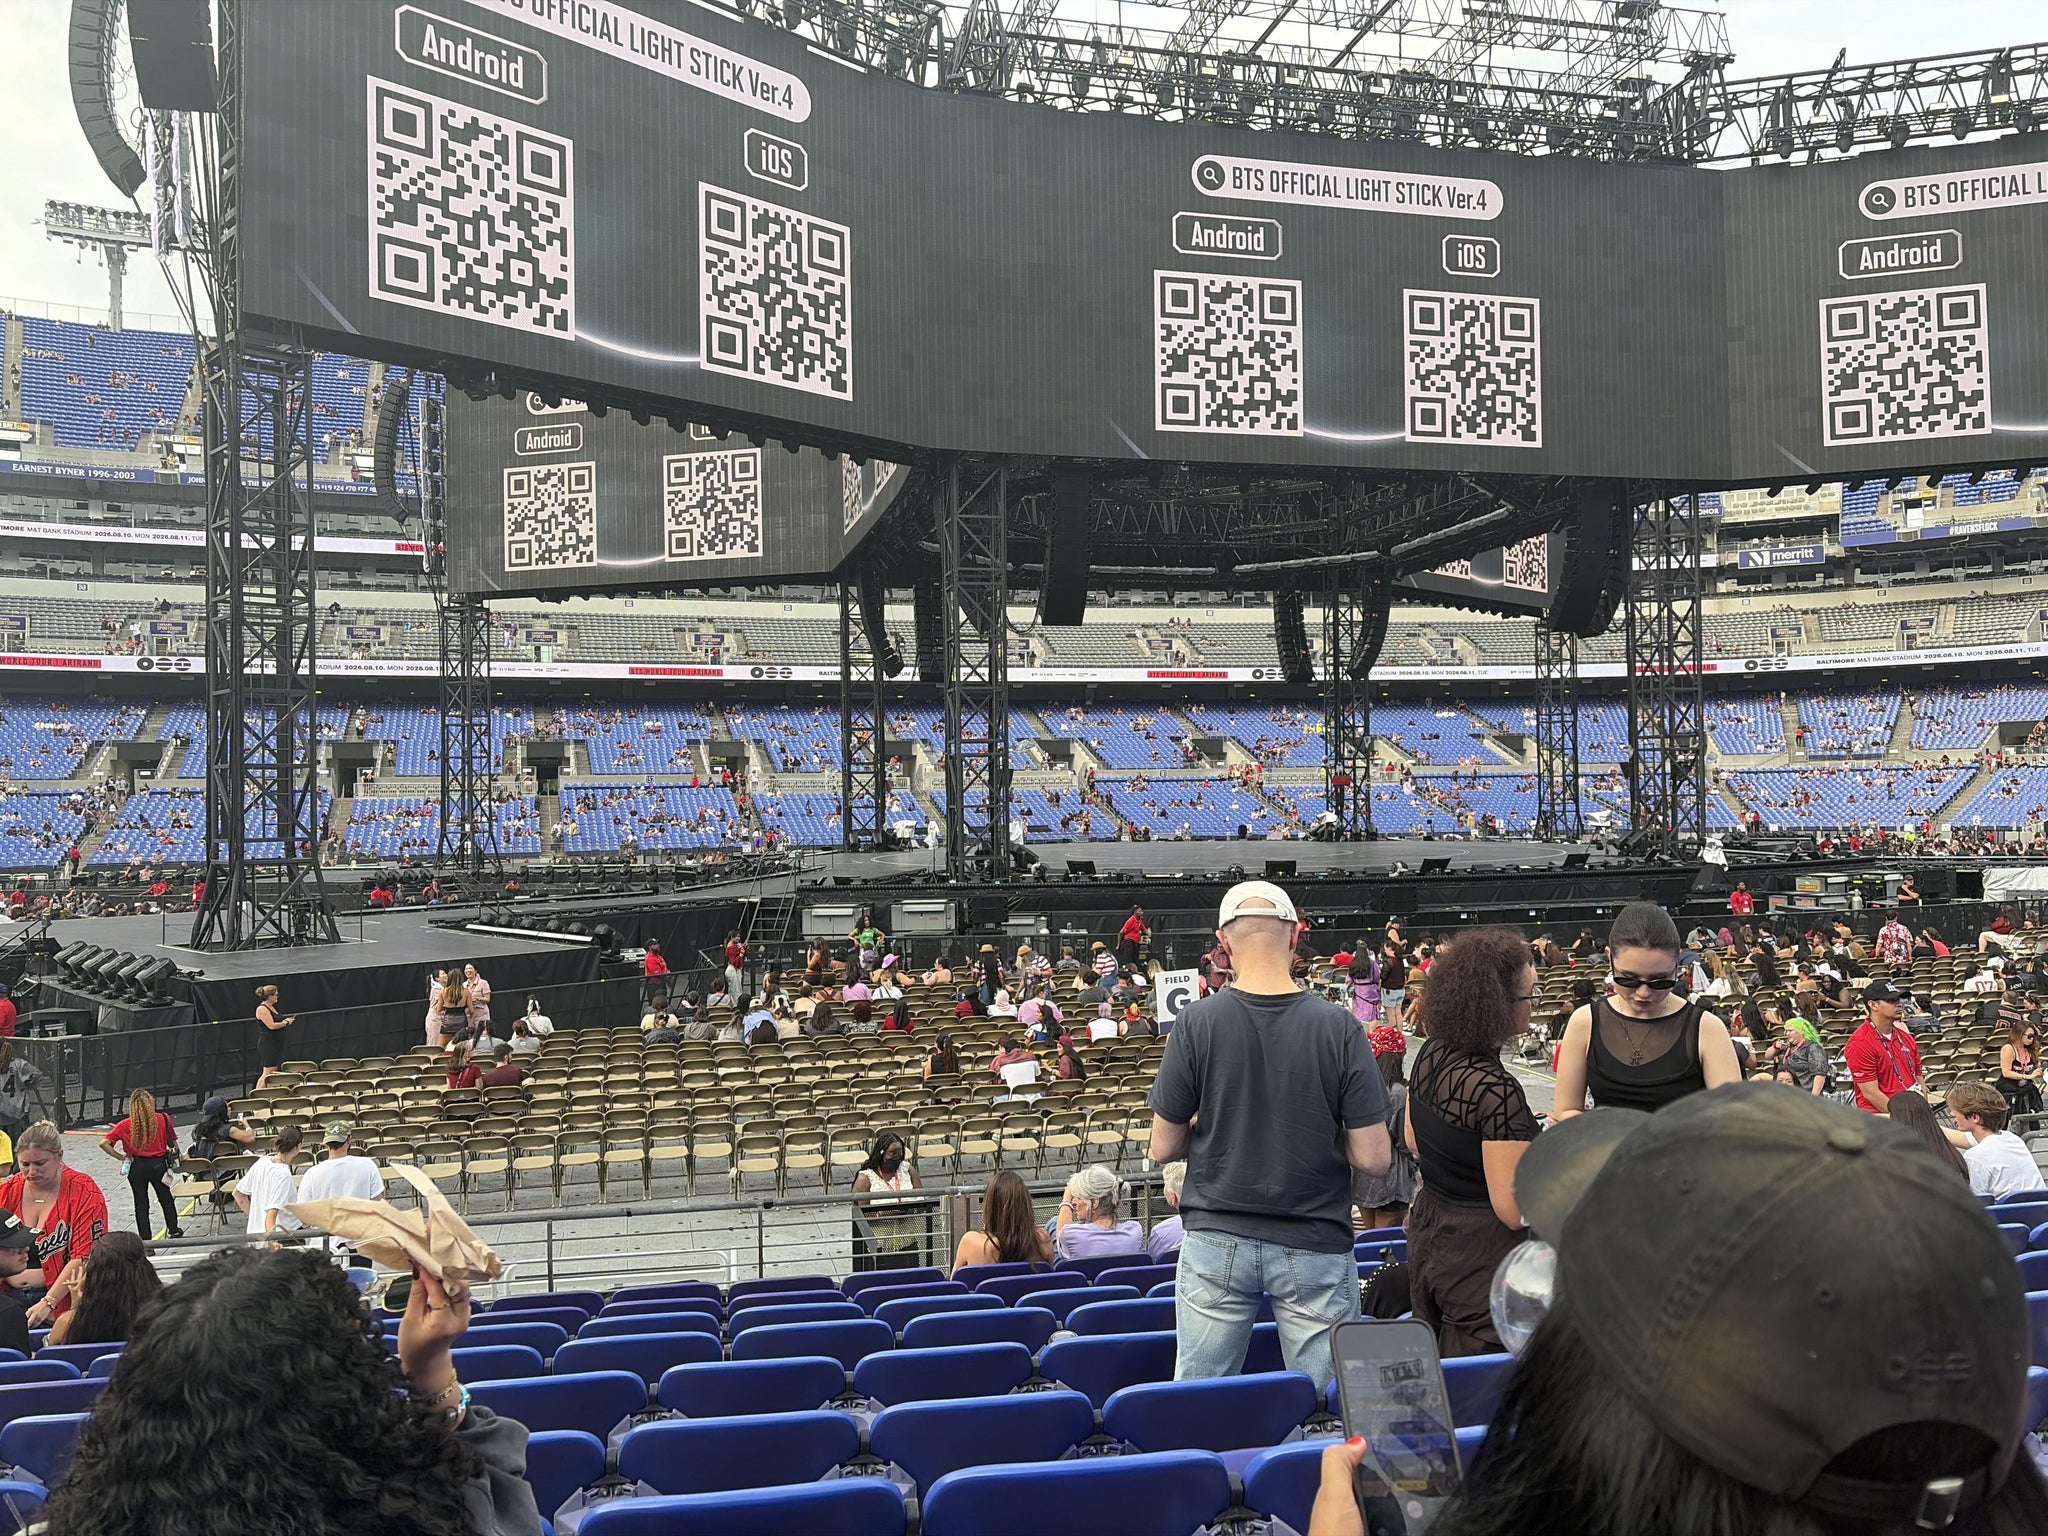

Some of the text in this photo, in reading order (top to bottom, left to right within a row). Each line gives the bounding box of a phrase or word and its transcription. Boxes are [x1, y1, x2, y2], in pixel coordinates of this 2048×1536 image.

[422, 23, 524, 90] Android
[629, 22, 685, 70] LIGHT
[690, 50, 745, 93] STICK
[748, 68, 795, 111] Ver.4
[760, 141, 793, 179] iOS
[1231, 166, 1488, 212] BTS OFFICIAL LIGHT STICK Ver.4
[1903, 182, 1941, 209] BTS
[1946, 172, 2032, 204] OFFICIAL
[1190, 219, 1265, 252] Android
[1456, 242, 1487, 270] iOS
[1859, 238, 1943, 271] Android
[525, 429, 572, 451] Android
[12, 463, 136, 480] EARNEST BYNER 1996-2003
[1699, 508, 1720, 516] ONOR
[63, 529, 92, 537] STADIUM
[1949, 521, 1998, 536] #RAVENSFLOCK
[1772, 548, 1814, 560] merritt
[0, 656, 98, 668] WORLD TOUR ARIRANG
[1165, 975, 1191, 985] FIELD
[1166, 987, 1192, 1016] G
